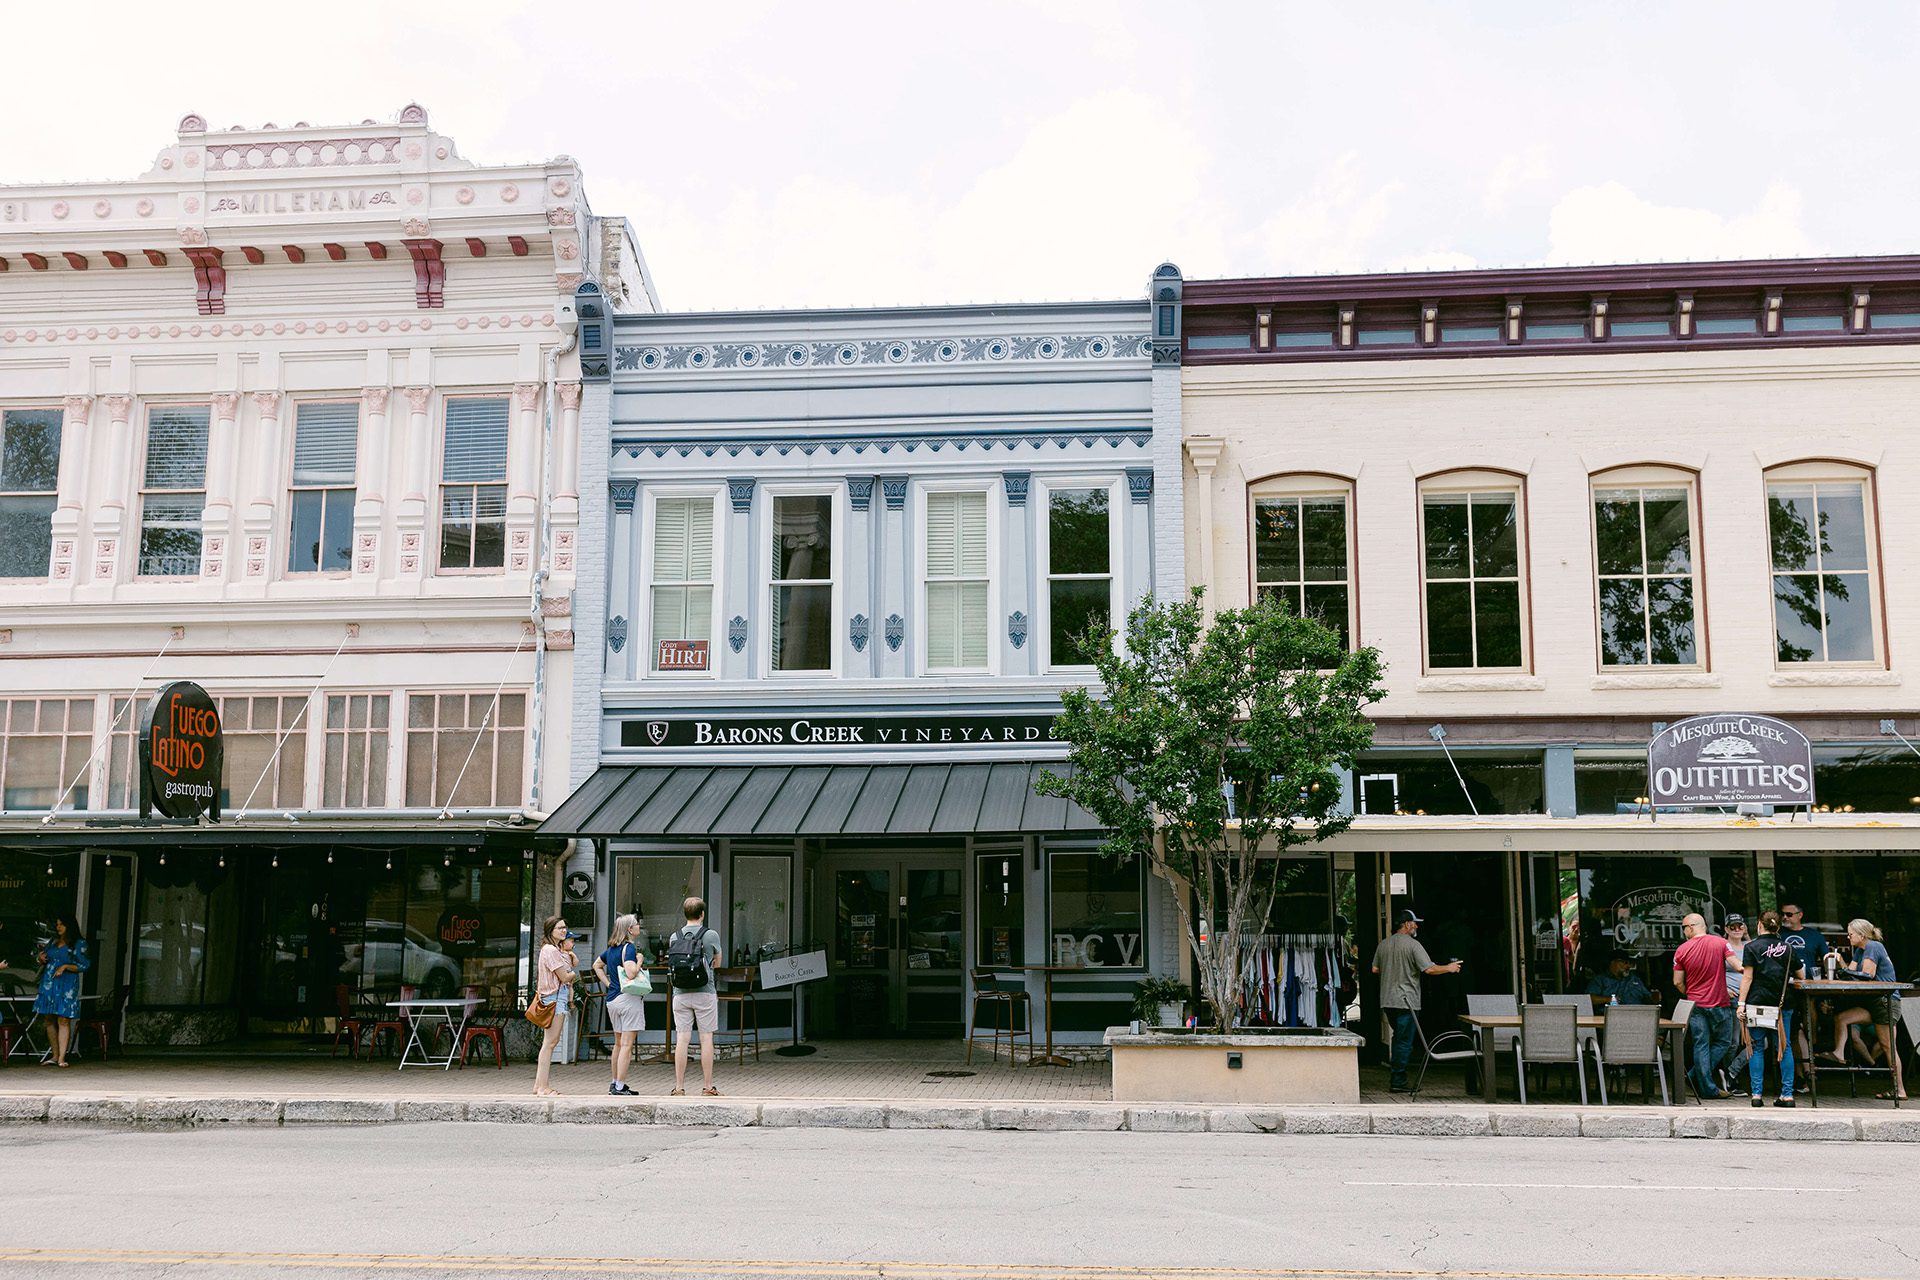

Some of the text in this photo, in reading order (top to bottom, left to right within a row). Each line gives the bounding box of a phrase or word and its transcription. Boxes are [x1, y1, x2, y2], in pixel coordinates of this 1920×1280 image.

[241, 189, 367, 214] MILEHAM
[659, 648, 706, 665] HIRT
[170, 693, 218, 740] FUEGO
[694, 722, 784, 744] BARONS
[790, 720, 864, 744] CREEK
[152, 725, 205, 777] LATINO
[164, 780, 214, 800] gastropub
[1655, 764, 1809, 797] OUTFITTERS
